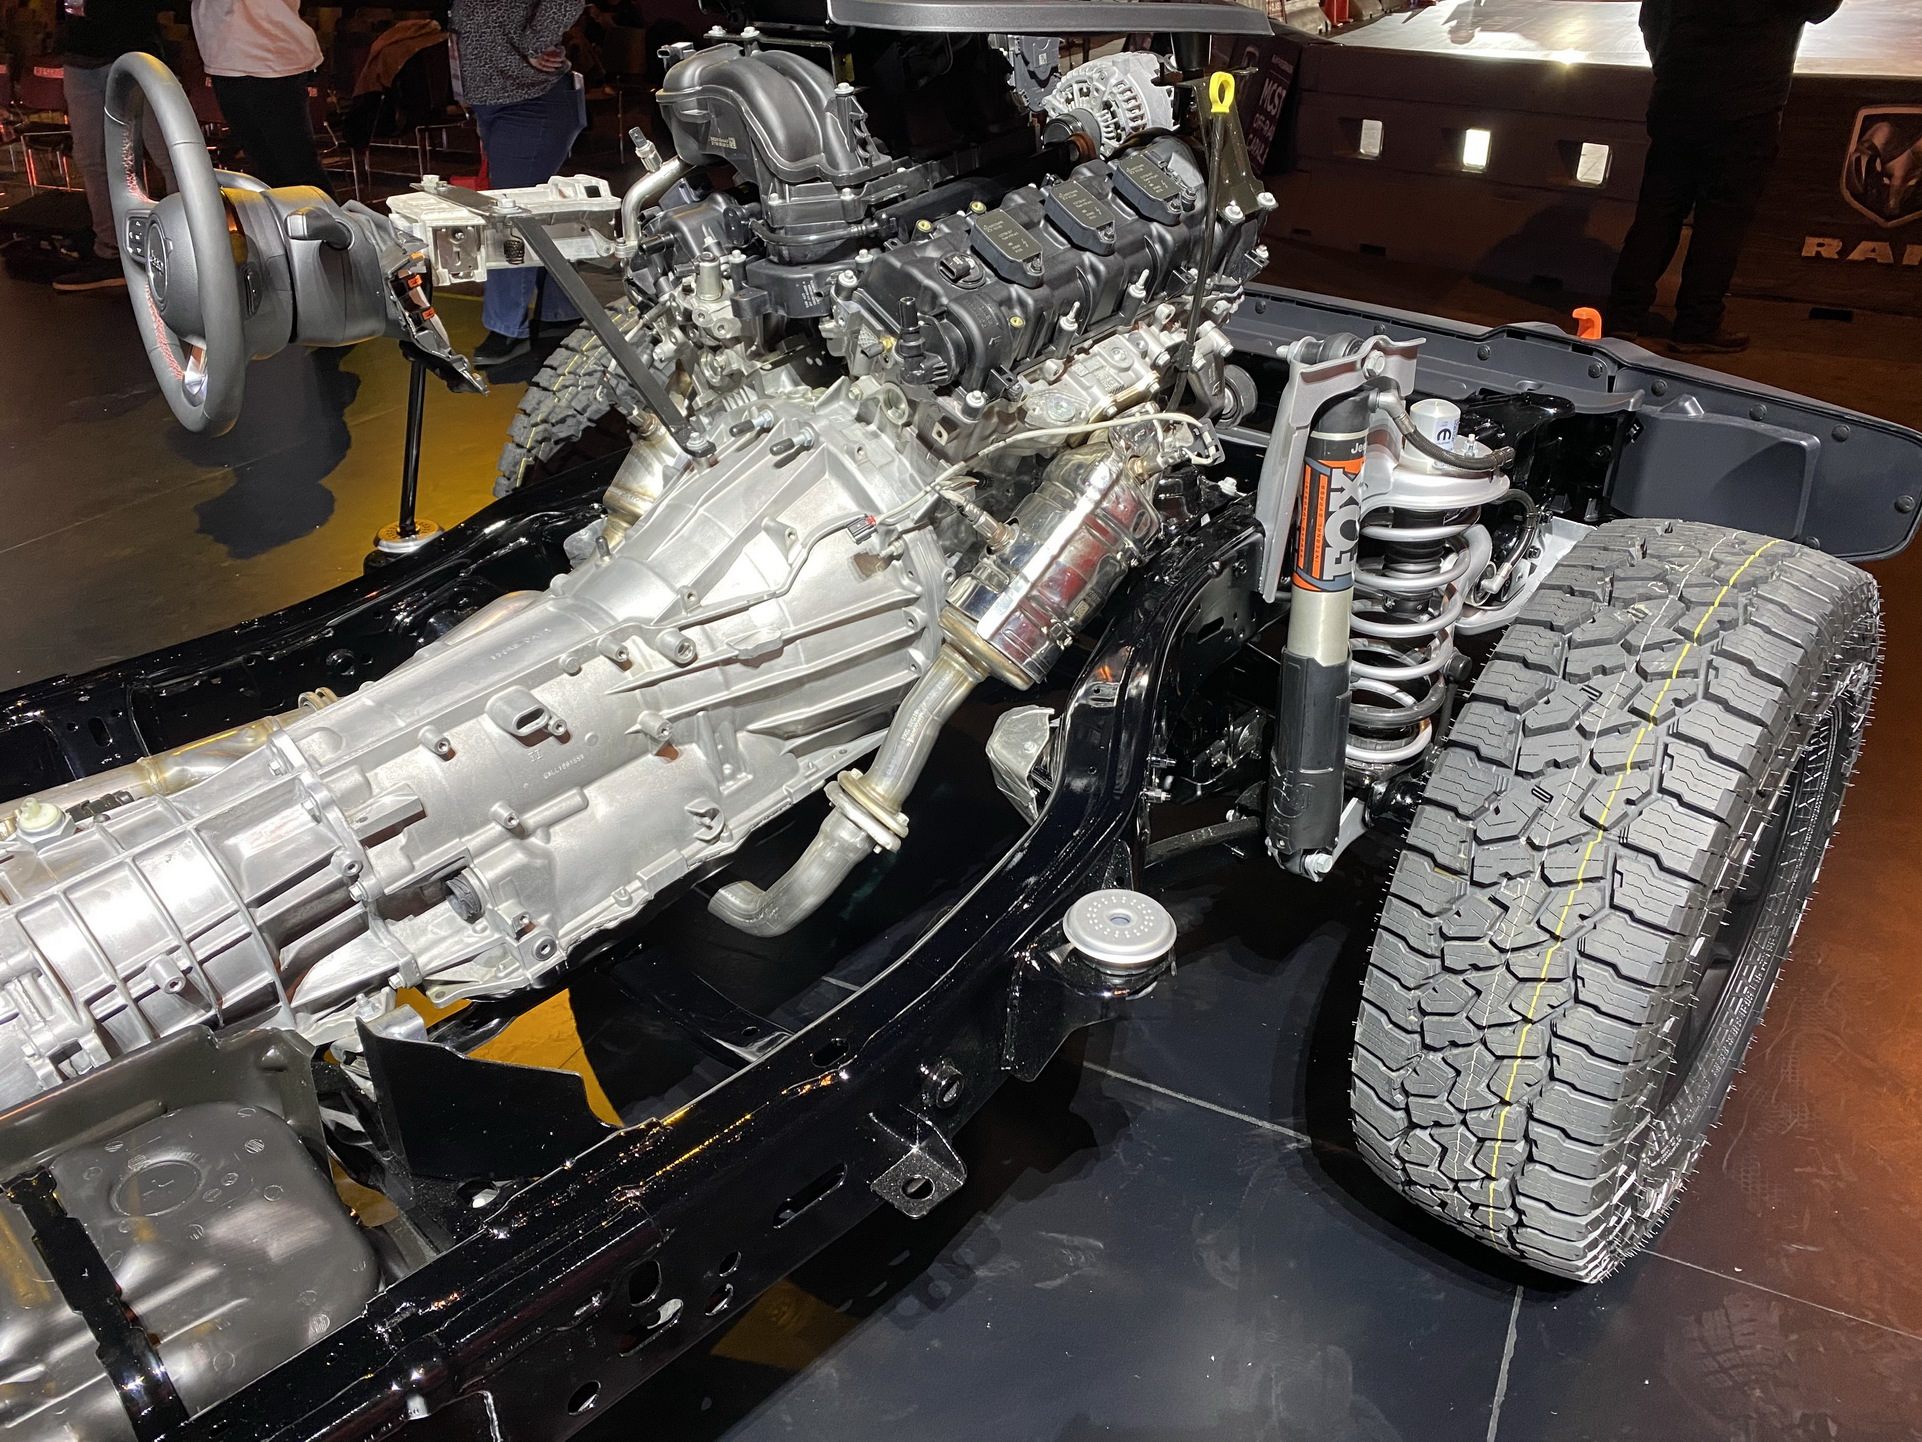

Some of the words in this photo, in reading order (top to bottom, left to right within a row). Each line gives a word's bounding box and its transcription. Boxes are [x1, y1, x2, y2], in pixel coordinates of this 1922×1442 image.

[1318, 485, 1326, 518] BYPASS
[1315, 522, 1323, 563] INTERNAL
[1323, 468, 1362, 580] FOX
